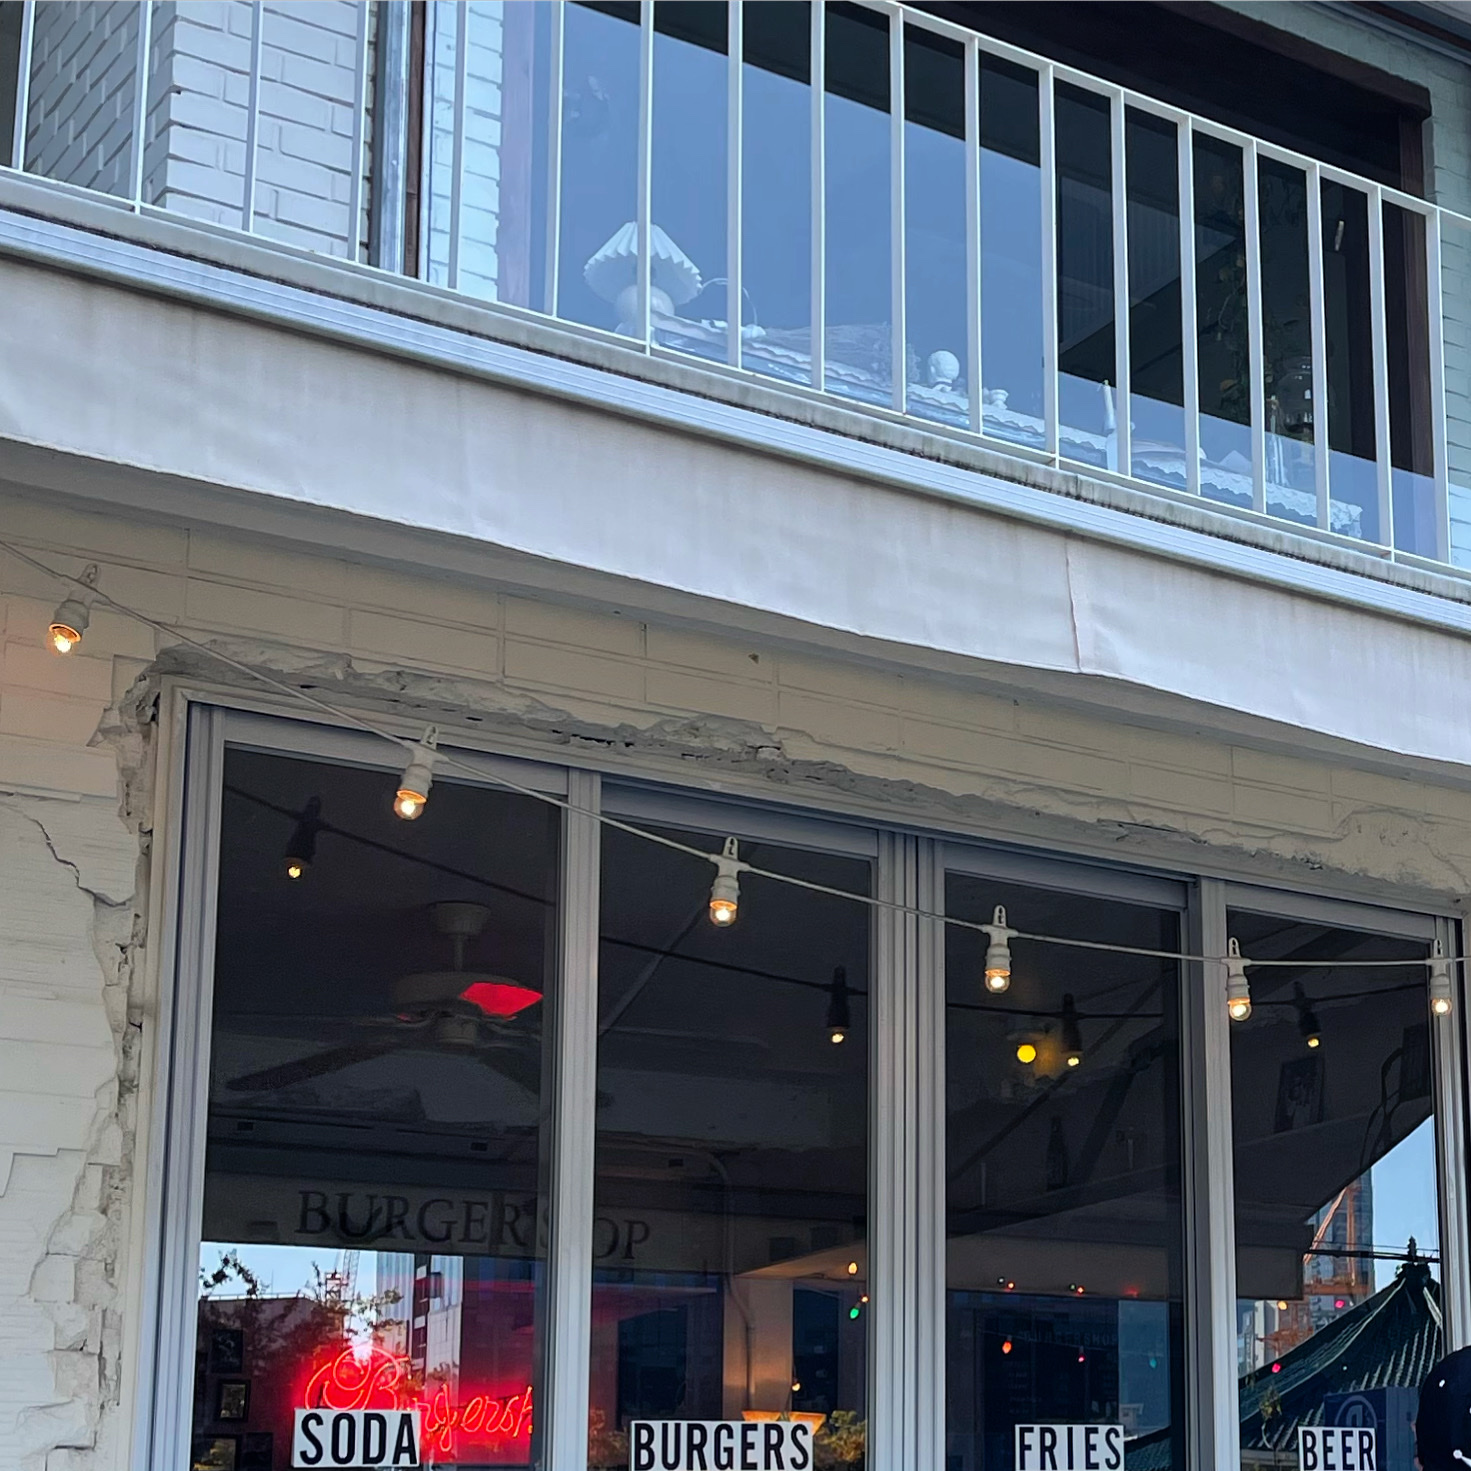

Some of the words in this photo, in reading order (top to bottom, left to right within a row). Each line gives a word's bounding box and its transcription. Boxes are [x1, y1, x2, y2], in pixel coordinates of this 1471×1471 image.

[299, 1412, 418, 1466] SODA
[633, 1422, 810, 1471] BURGERS
[1019, 1426, 1121, 1471] FRIES
[1301, 1428, 1376, 1471] BEER
